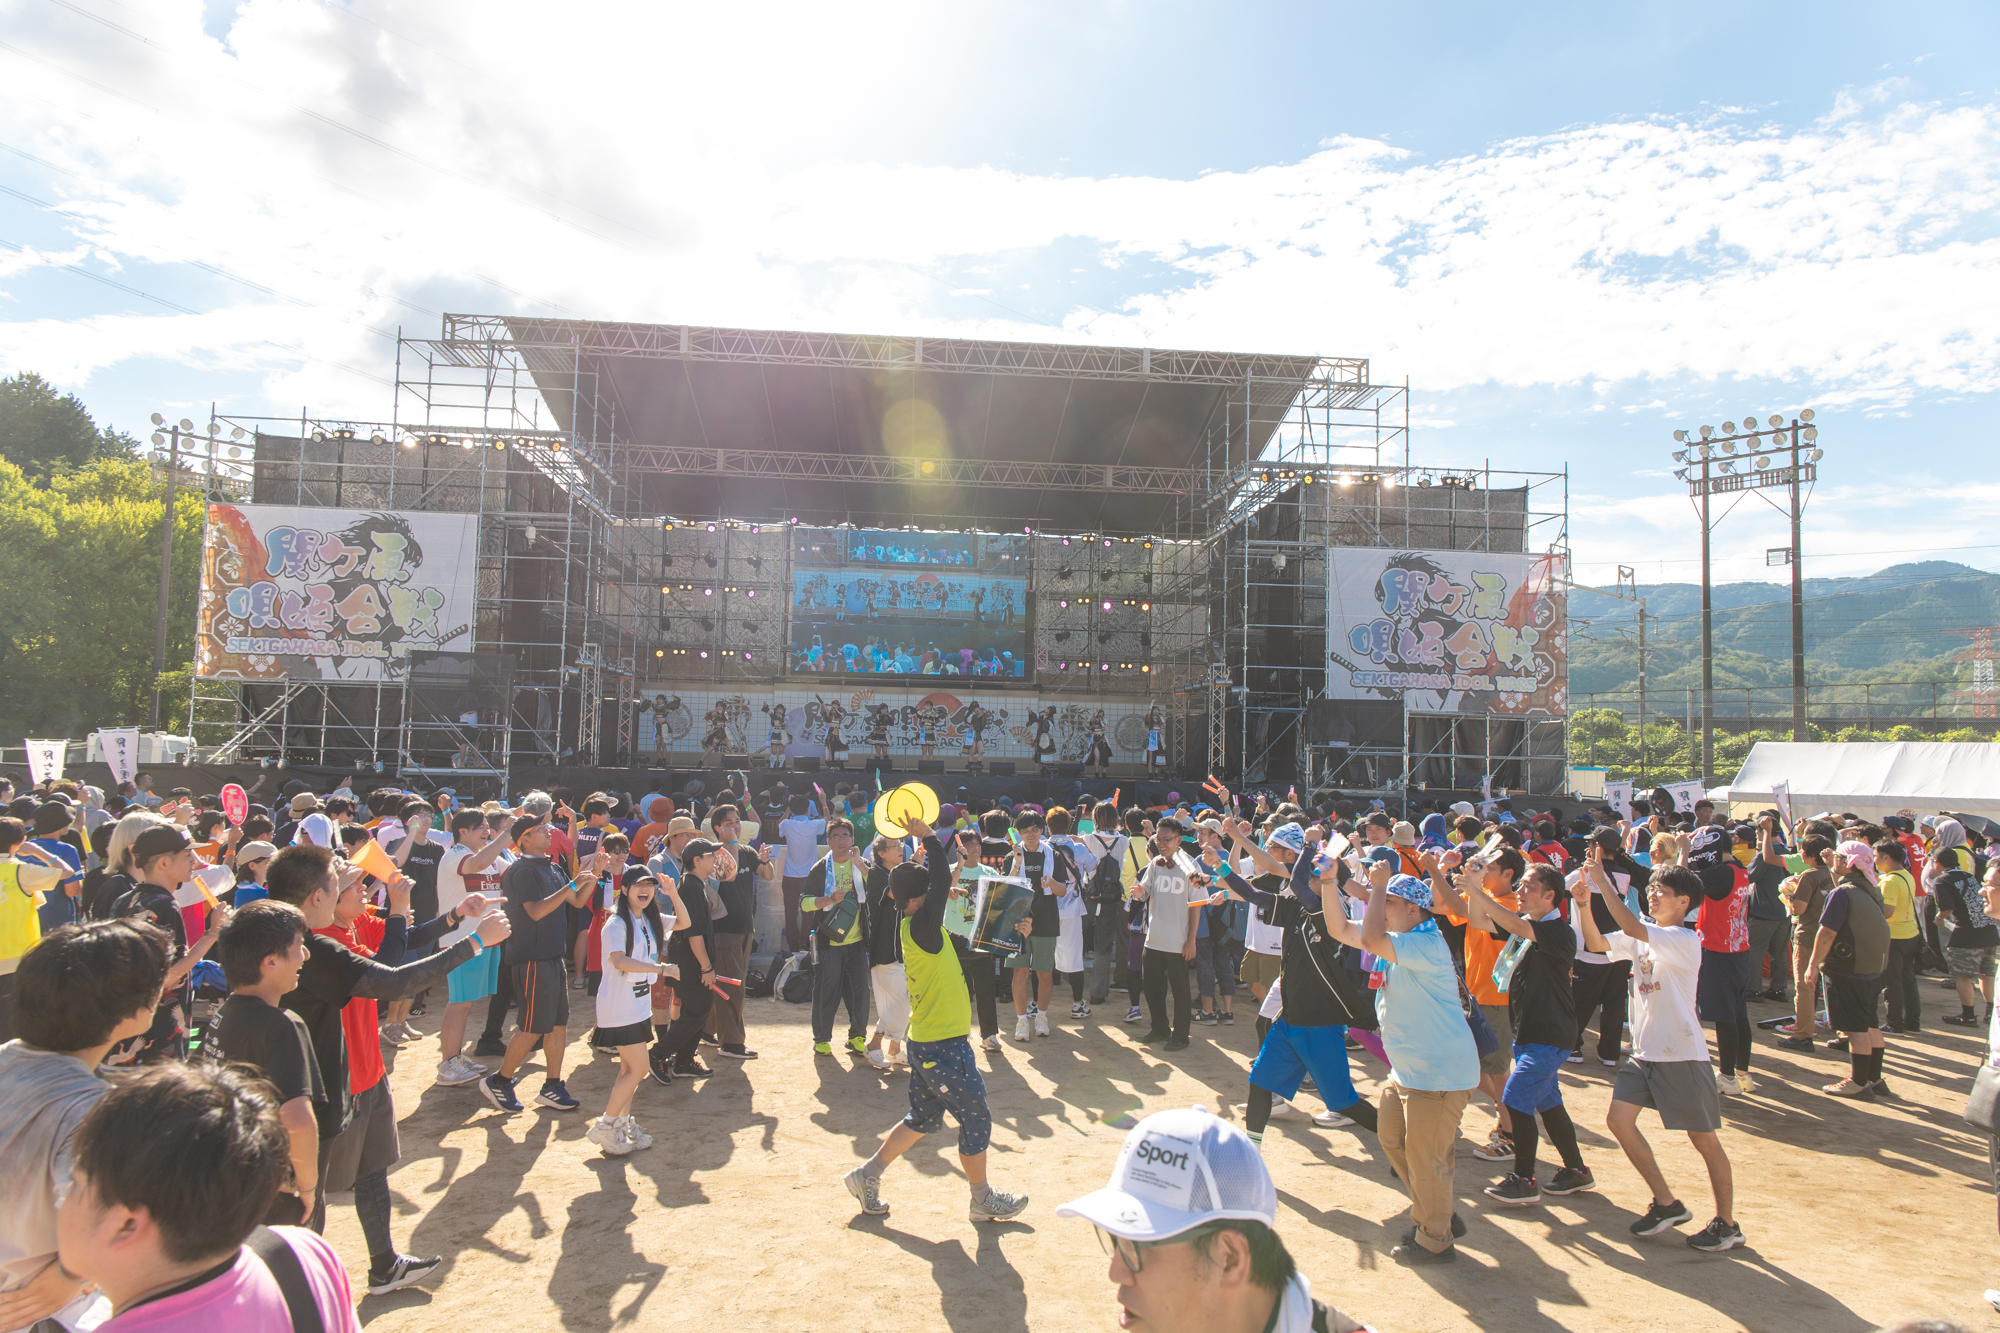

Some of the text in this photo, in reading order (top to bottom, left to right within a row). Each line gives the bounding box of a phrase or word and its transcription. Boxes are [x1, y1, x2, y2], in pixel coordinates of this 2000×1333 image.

[225, 581, 444, 638] 唄姫合戦
[226, 638, 338, 655] SEKIGAHARA
[342, 641, 388, 656] IDOL
[1349, 619, 1539, 672] 唄姫合戦
[1352, 672, 1537, 692] SEKIGAHARA IDOL WARS
[1137, 1140, 1189, 1171] Sport
